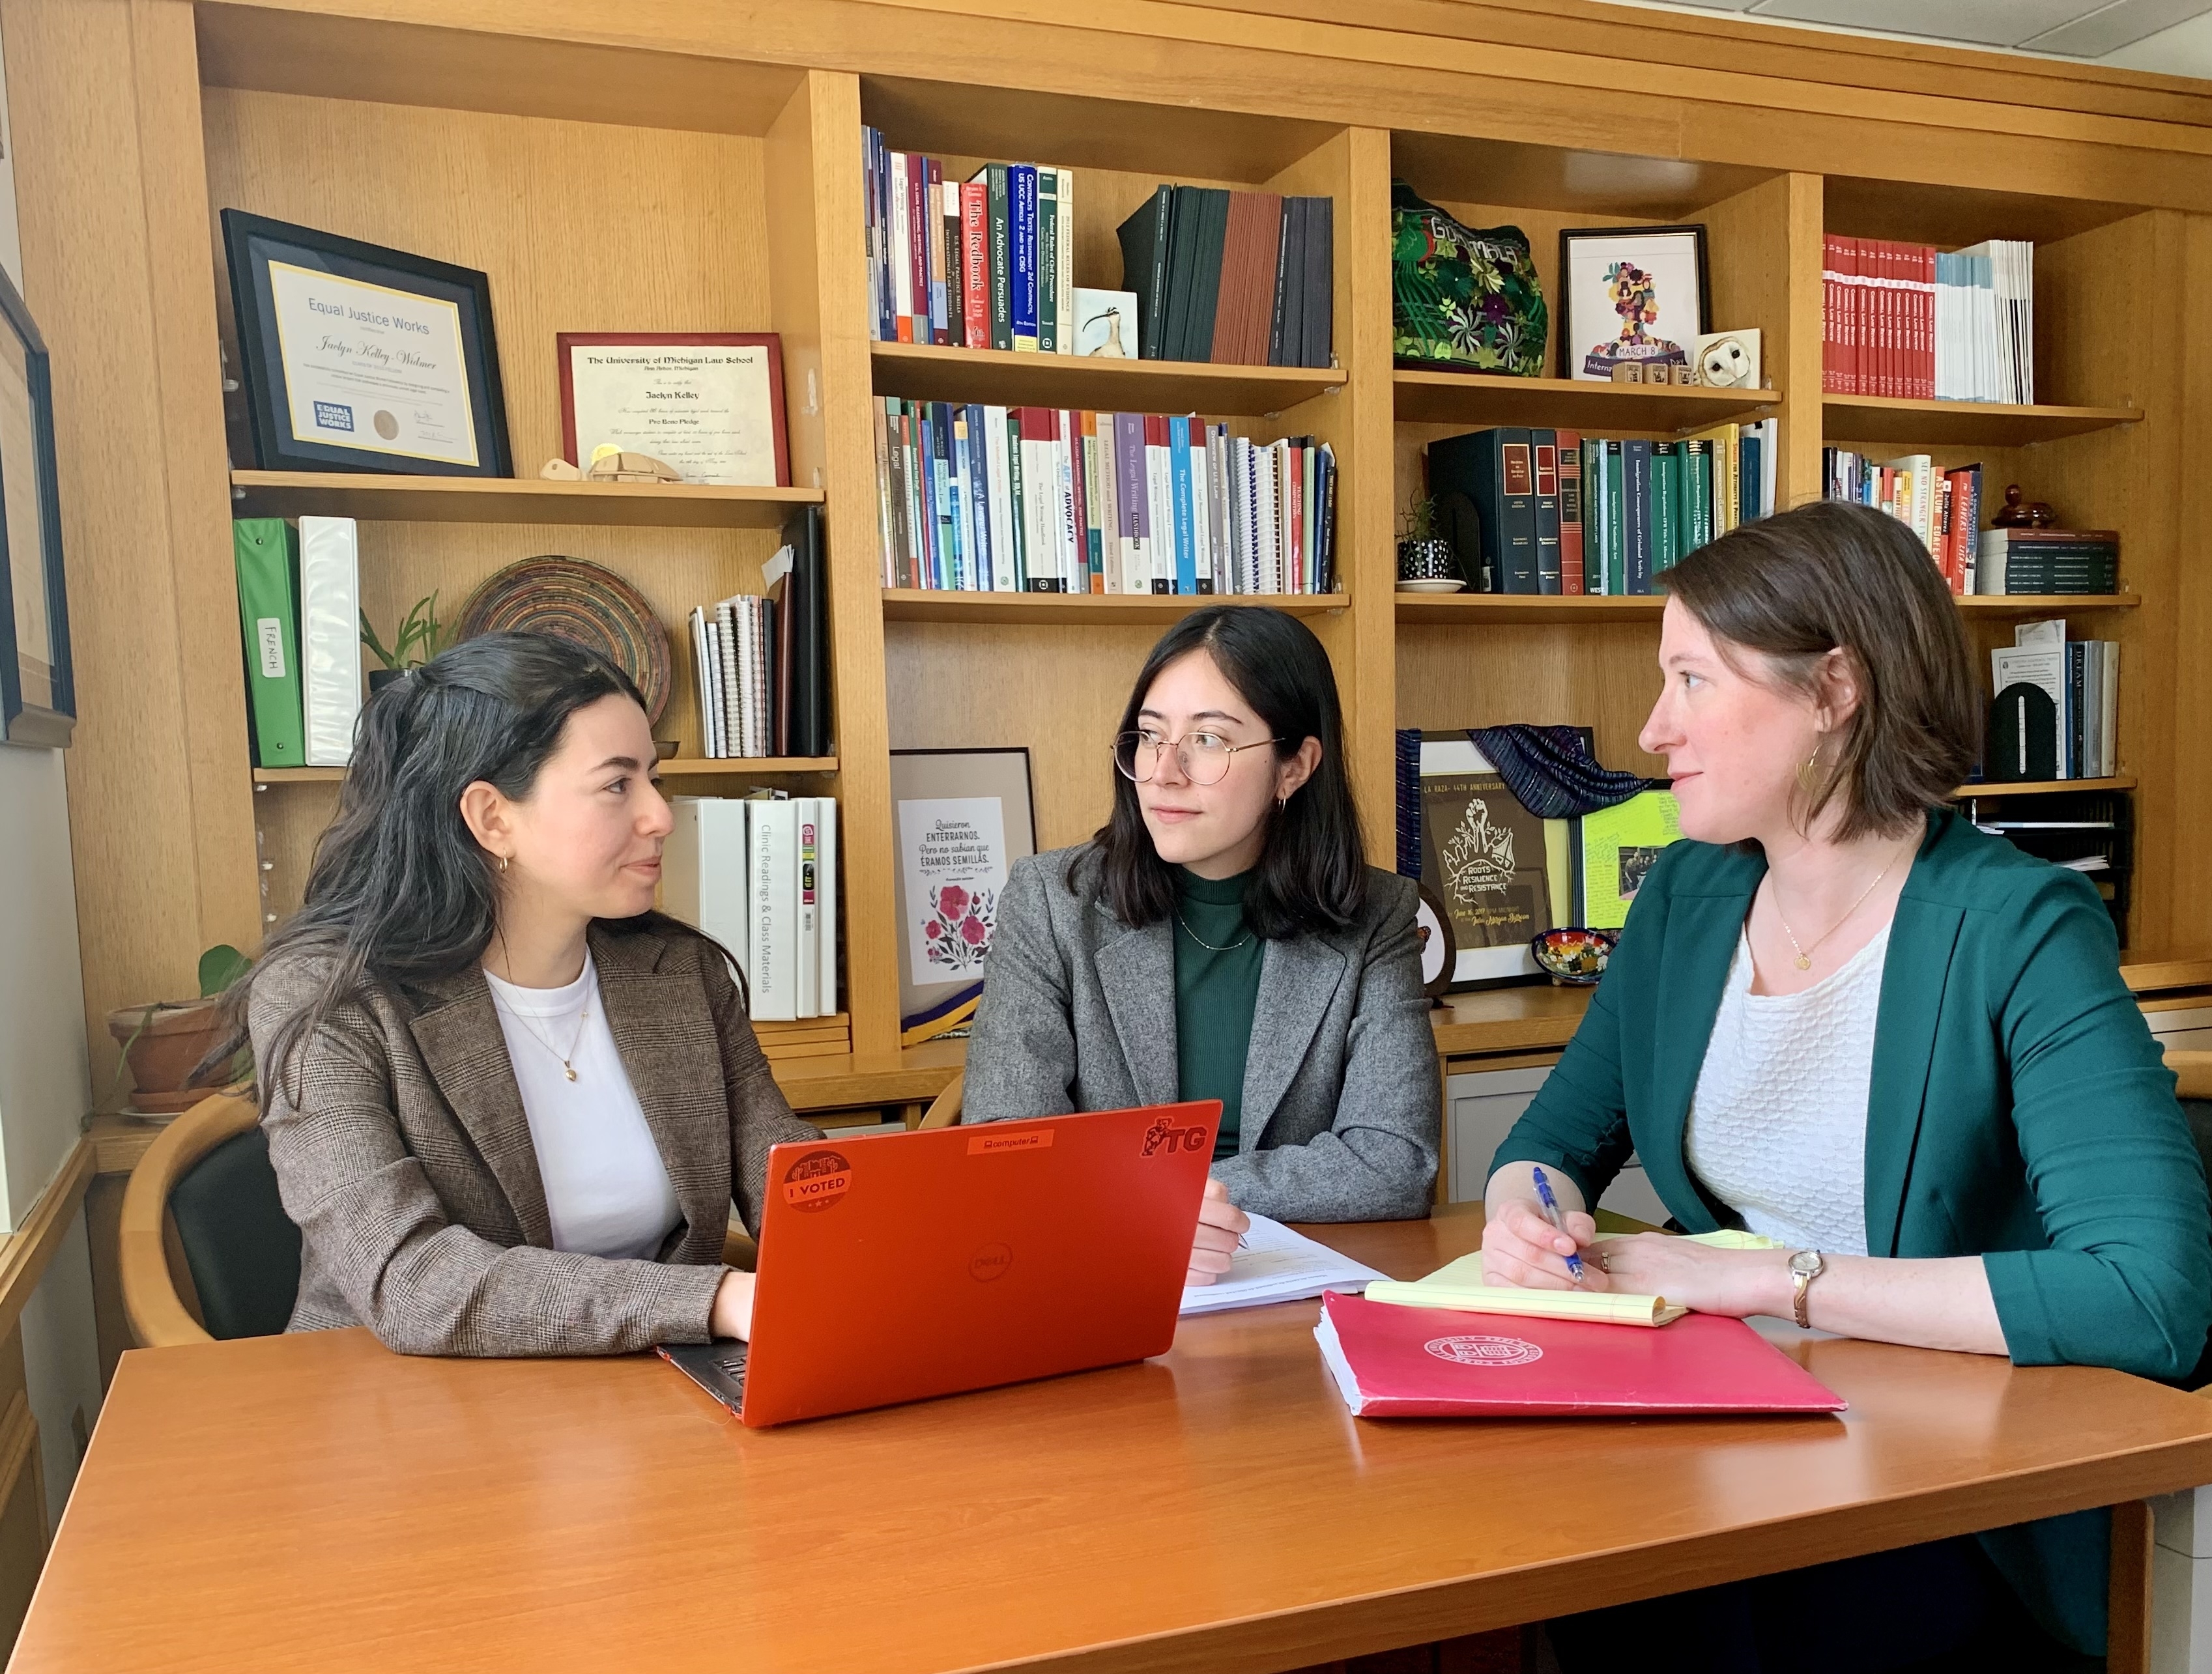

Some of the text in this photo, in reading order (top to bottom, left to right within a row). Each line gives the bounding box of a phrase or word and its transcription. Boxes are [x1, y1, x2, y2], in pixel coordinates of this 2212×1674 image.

[1018, 173, 1024, 182] US
[969, 201, 984, 291] The Redbook
[996, 218, 1007, 323] An Advocate Persuades
[1028, 272, 1033, 281] 2d
[309, 298, 344, 317] Equal
[349, 307, 390, 327] Justice
[392, 317, 430, 335] Works
[316, 335, 352, 357] Jaclyn
[1619, 347, 1656, 356] MARCH 8
[606, 356, 651, 365] University
[663, 356, 703, 365] Michigan
[1587, 360, 1613, 373] Interna
[646, 391, 700, 400] Jaclyn Kelley
[317, 404, 352, 429] EQUAL JUSTICE WORKS
[891, 446, 900, 469] Legal
[1129, 459, 1138, 481] Legal
[1921, 475, 1928, 485] NO
[1130, 483, 1139, 513] Writing
[977, 501, 986, 528] Lawyer
[1065, 491, 1074, 543] ADVOCACY
[1932, 475, 1944, 553] ASYLUM EDAFE
[1959, 496, 1968, 532] LEAVERS
[1180, 518, 1189, 537] Legal
[1958, 563, 1964, 575] KO
[265, 626, 278, 670] FRENCH
[1470, 782, 1505, 791] ANNIVERSARY
[936, 819, 971, 830] Quisieron
[926, 831, 980, 842] ENTERRARNOS.
[919, 844, 938, 855] Pero
[951, 844, 975, 853] sabían
[977, 845, 990, 856] que
[921, 854, 989, 866] ÉRAMOS SEMILLAS.
[1467, 865, 1491, 874] ROOTS
[1463, 874, 1498, 885] RESILIENCE
[1469, 883, 1506, 893] RESISTANCE
[760, 824, 771, 993] Clinic Readings & Class Materials
[992, 1137, 1030, 1148] computer
[1167, 1126, 1208, 1154] TG
[788, 1176, 846, 1199] I VOTED
[974, 1256, 1005, 1269] DELL
